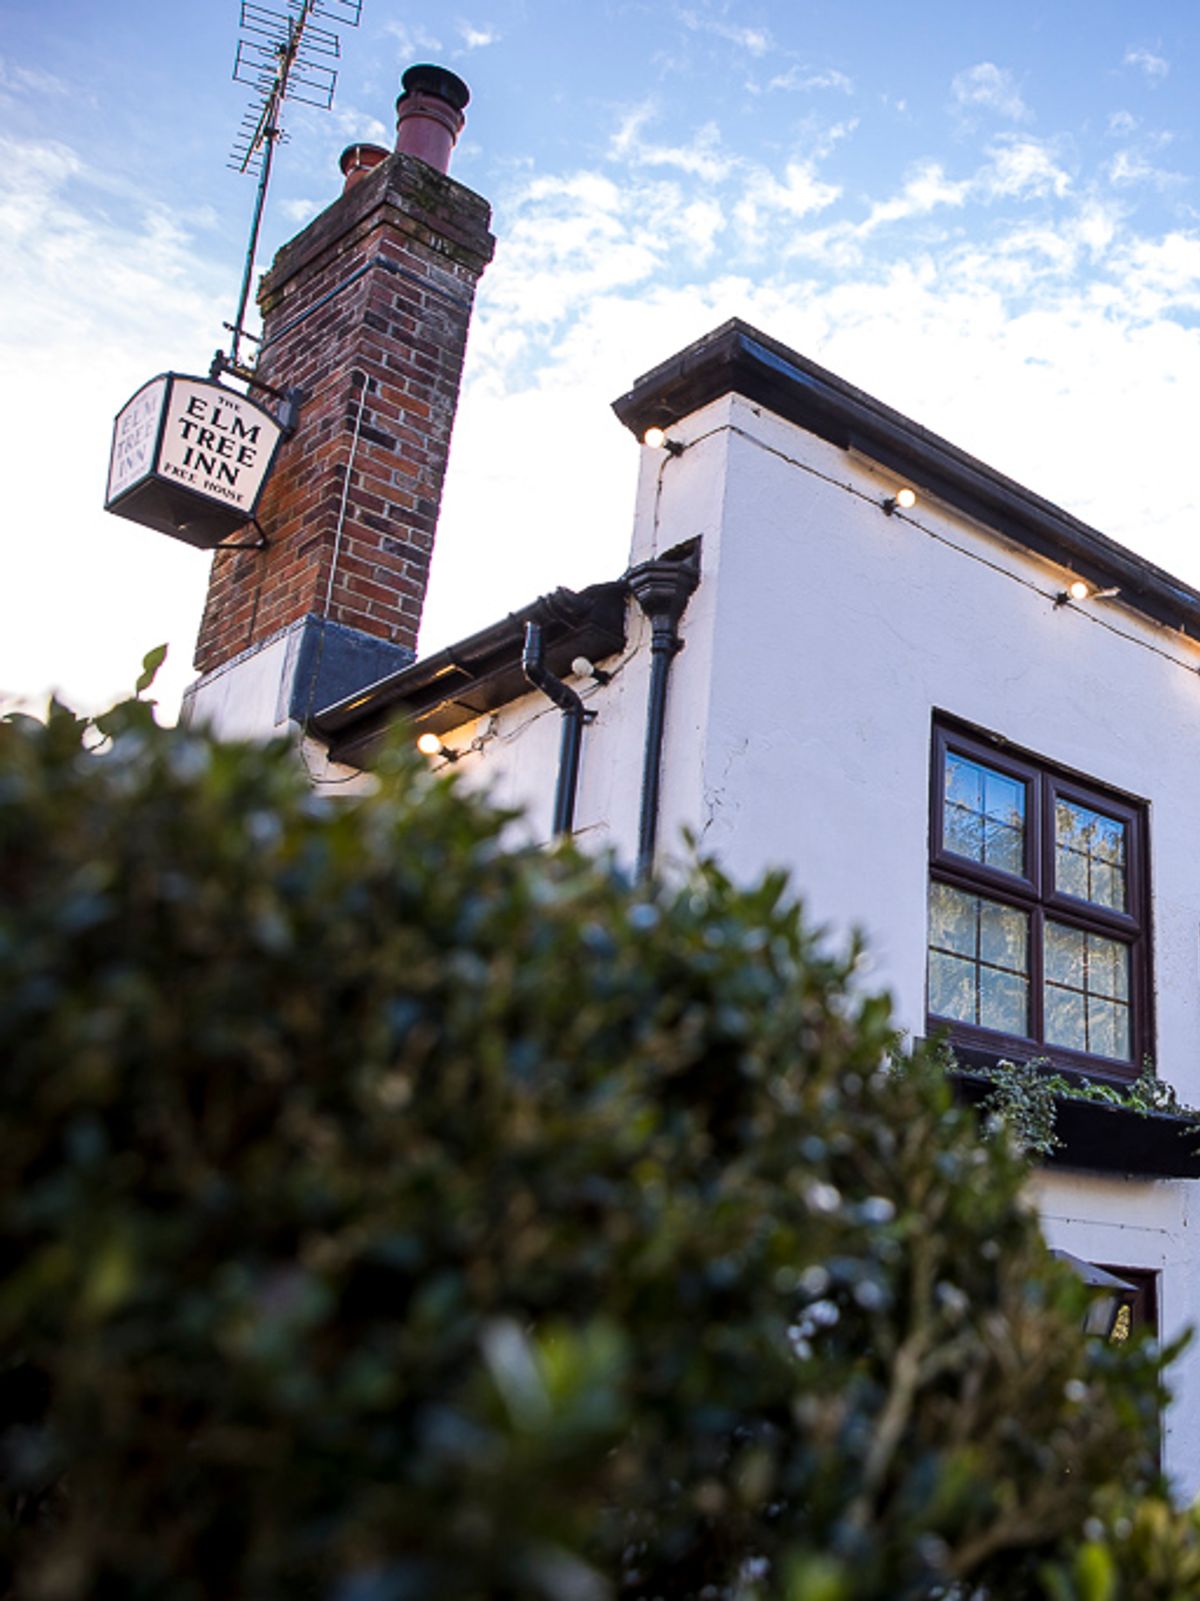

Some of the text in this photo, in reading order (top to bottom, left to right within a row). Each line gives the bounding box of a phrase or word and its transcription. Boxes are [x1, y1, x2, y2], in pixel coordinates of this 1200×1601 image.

[186, 396, 261, 444] ELM
[218, 396, 241, 412] THE
[178, 417, 257, 467] TREE
[163, 461, 197, 484] FREE
[204, 480, 245, 503] HOUSE
[182, 447, 240, 486] INN
